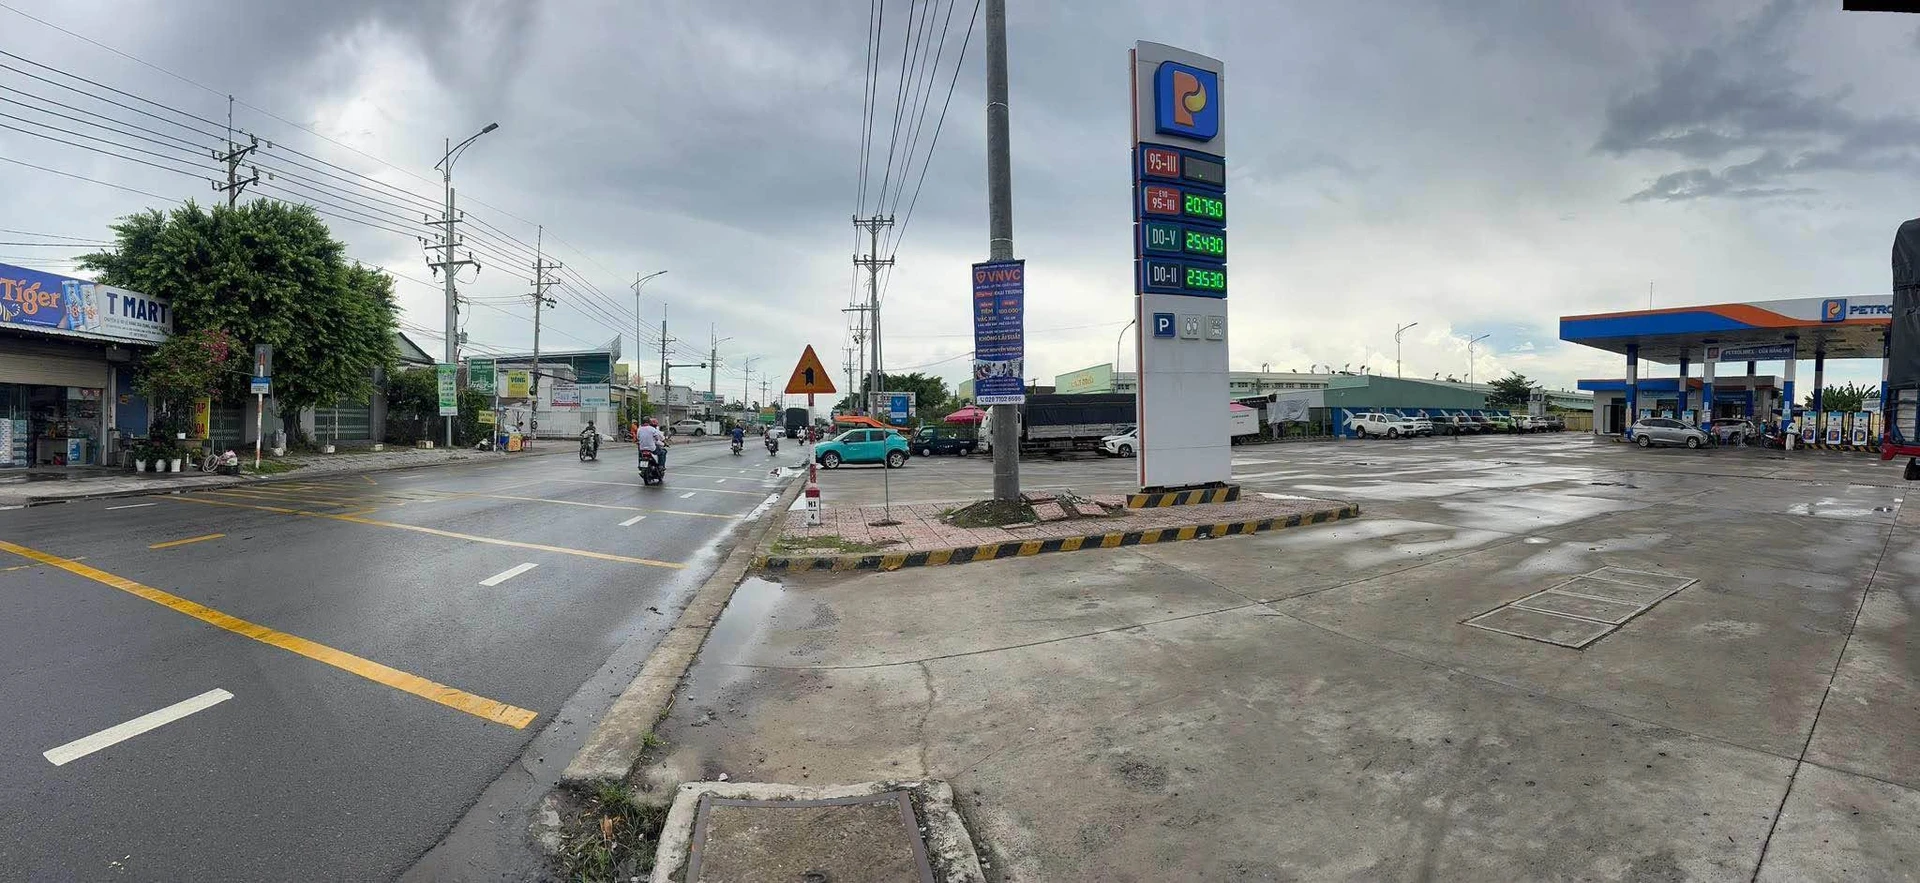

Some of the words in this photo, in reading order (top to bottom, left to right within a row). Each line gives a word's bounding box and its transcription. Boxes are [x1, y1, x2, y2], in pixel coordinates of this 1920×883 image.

[1149, 152, 1176, 173] 95-III
[1152, 197, 1175, 211] 95-III
[1185, 195, 1223, 217] 20.750
[1152, 228, 1176, 246] DO-V
[1186, 233, 1224, 253] 25.430
[987, 269, 1021, 282] VNVC
[1153, 266, 1177, 283] DO-II
[0, 277, 60, 315] Tiger
[106, 292, 118, 314] T
[123, 295, 168, 323] MART
[1159, 318, 1169, 332] P
